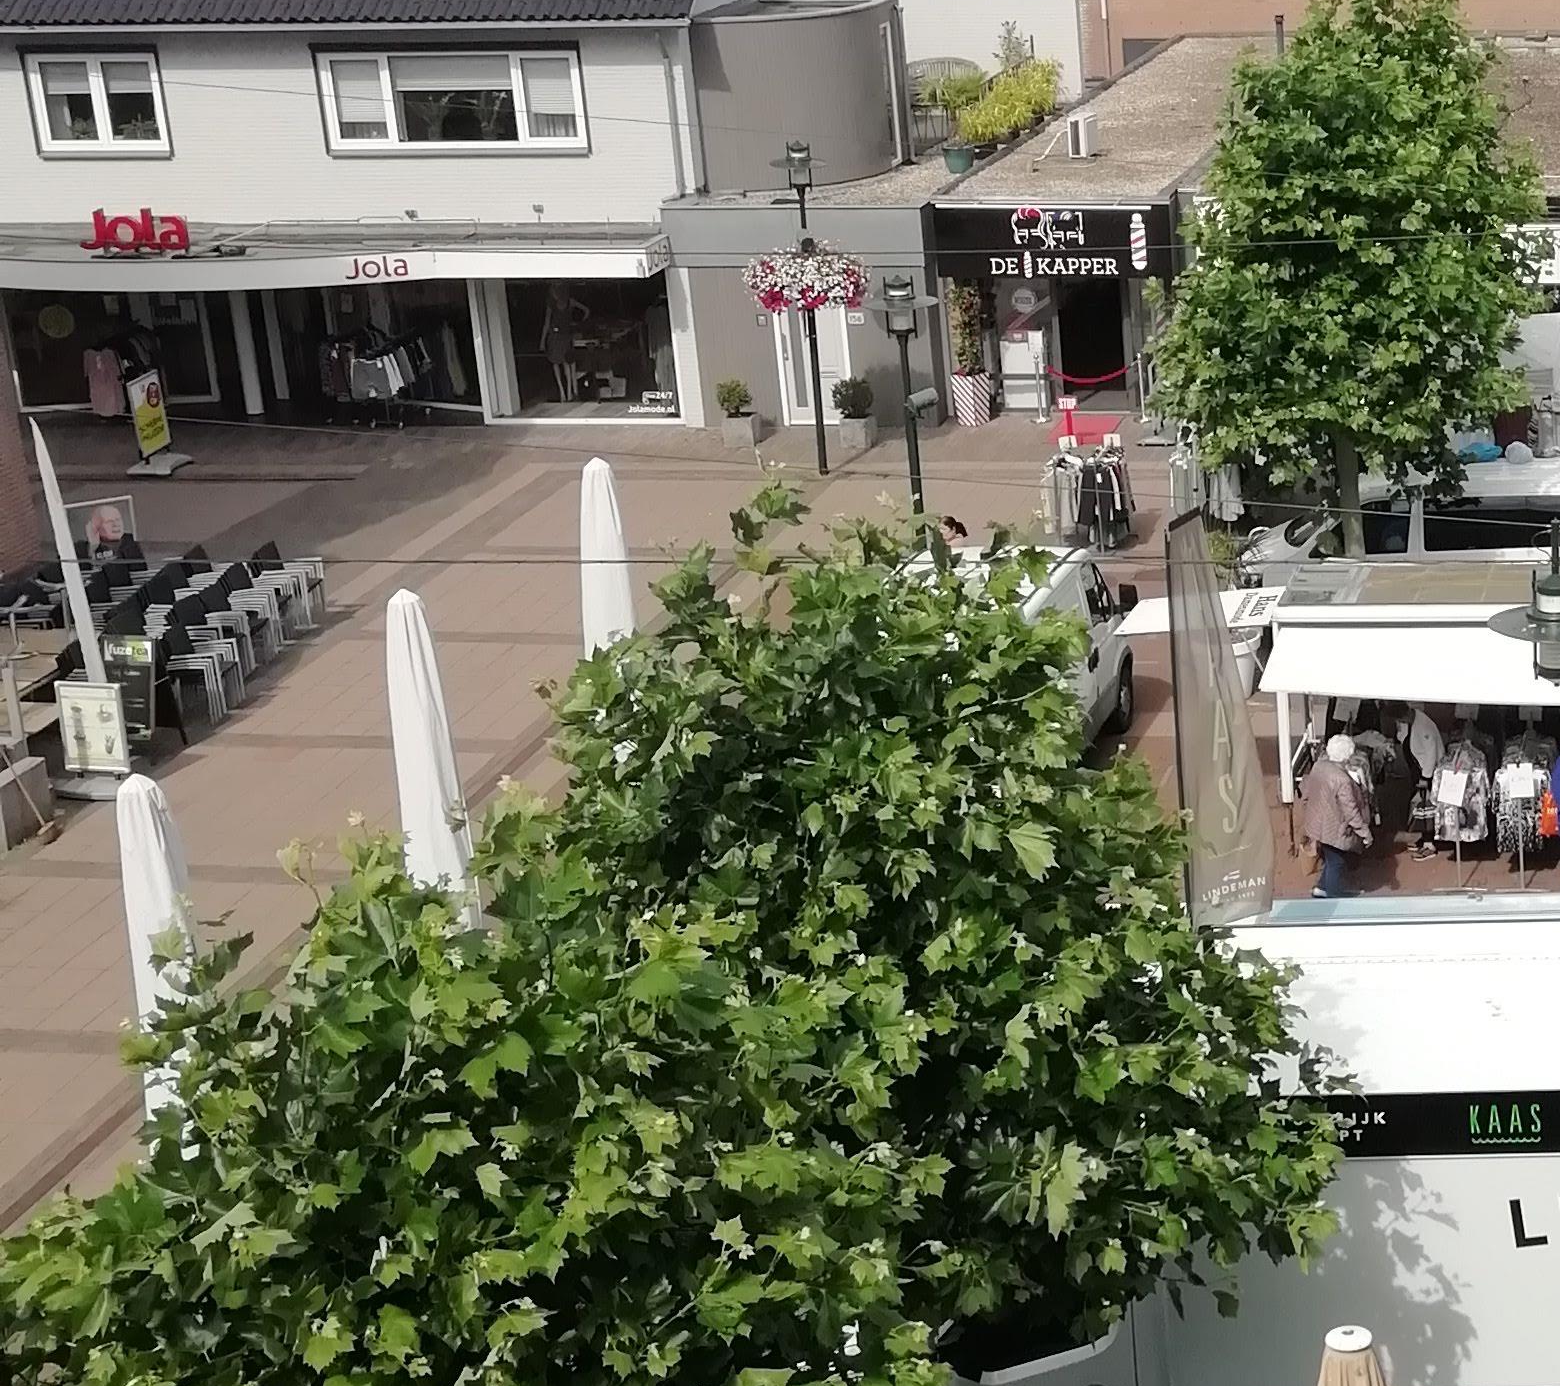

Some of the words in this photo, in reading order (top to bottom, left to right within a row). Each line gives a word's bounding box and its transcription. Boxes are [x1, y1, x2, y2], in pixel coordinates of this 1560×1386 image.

[80, 207, 190, 250] Jola
[345, 255, 410, 280] Jola
[989, 257, 1019, 275] DE
[1036, 256, 1119, 275] KAPPER
[1058, 397, 1077, 409] STOP
[1202, 877, 1267, 902] LINDEMAN
[1469, 1104, 1541, 1135] KAAS
